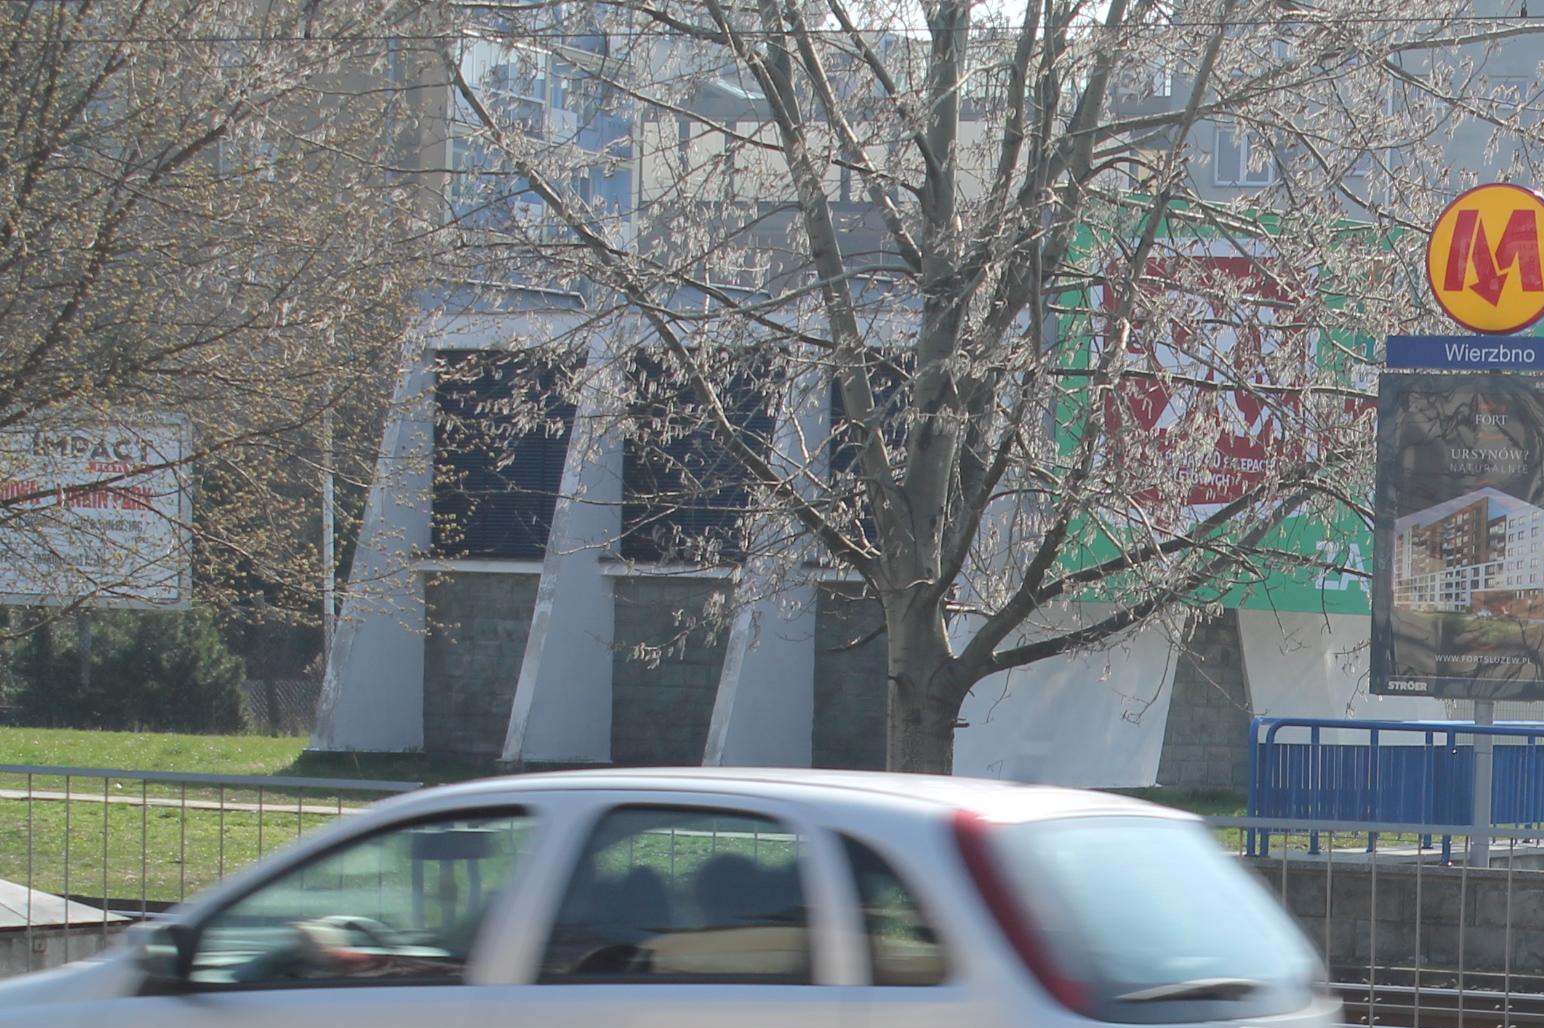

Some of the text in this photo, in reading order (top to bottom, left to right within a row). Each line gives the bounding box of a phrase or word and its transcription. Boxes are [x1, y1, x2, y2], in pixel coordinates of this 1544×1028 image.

[1444, 343, 1536, 363] Wierzbno
[1475, 413, 1508, 427] FORT
[1450, 447, 1529, 461] URSYNÓW?
[1449, 463, 1529, 474] NATURALNIE
[1387, 680, 1428, 692] STRÖER
